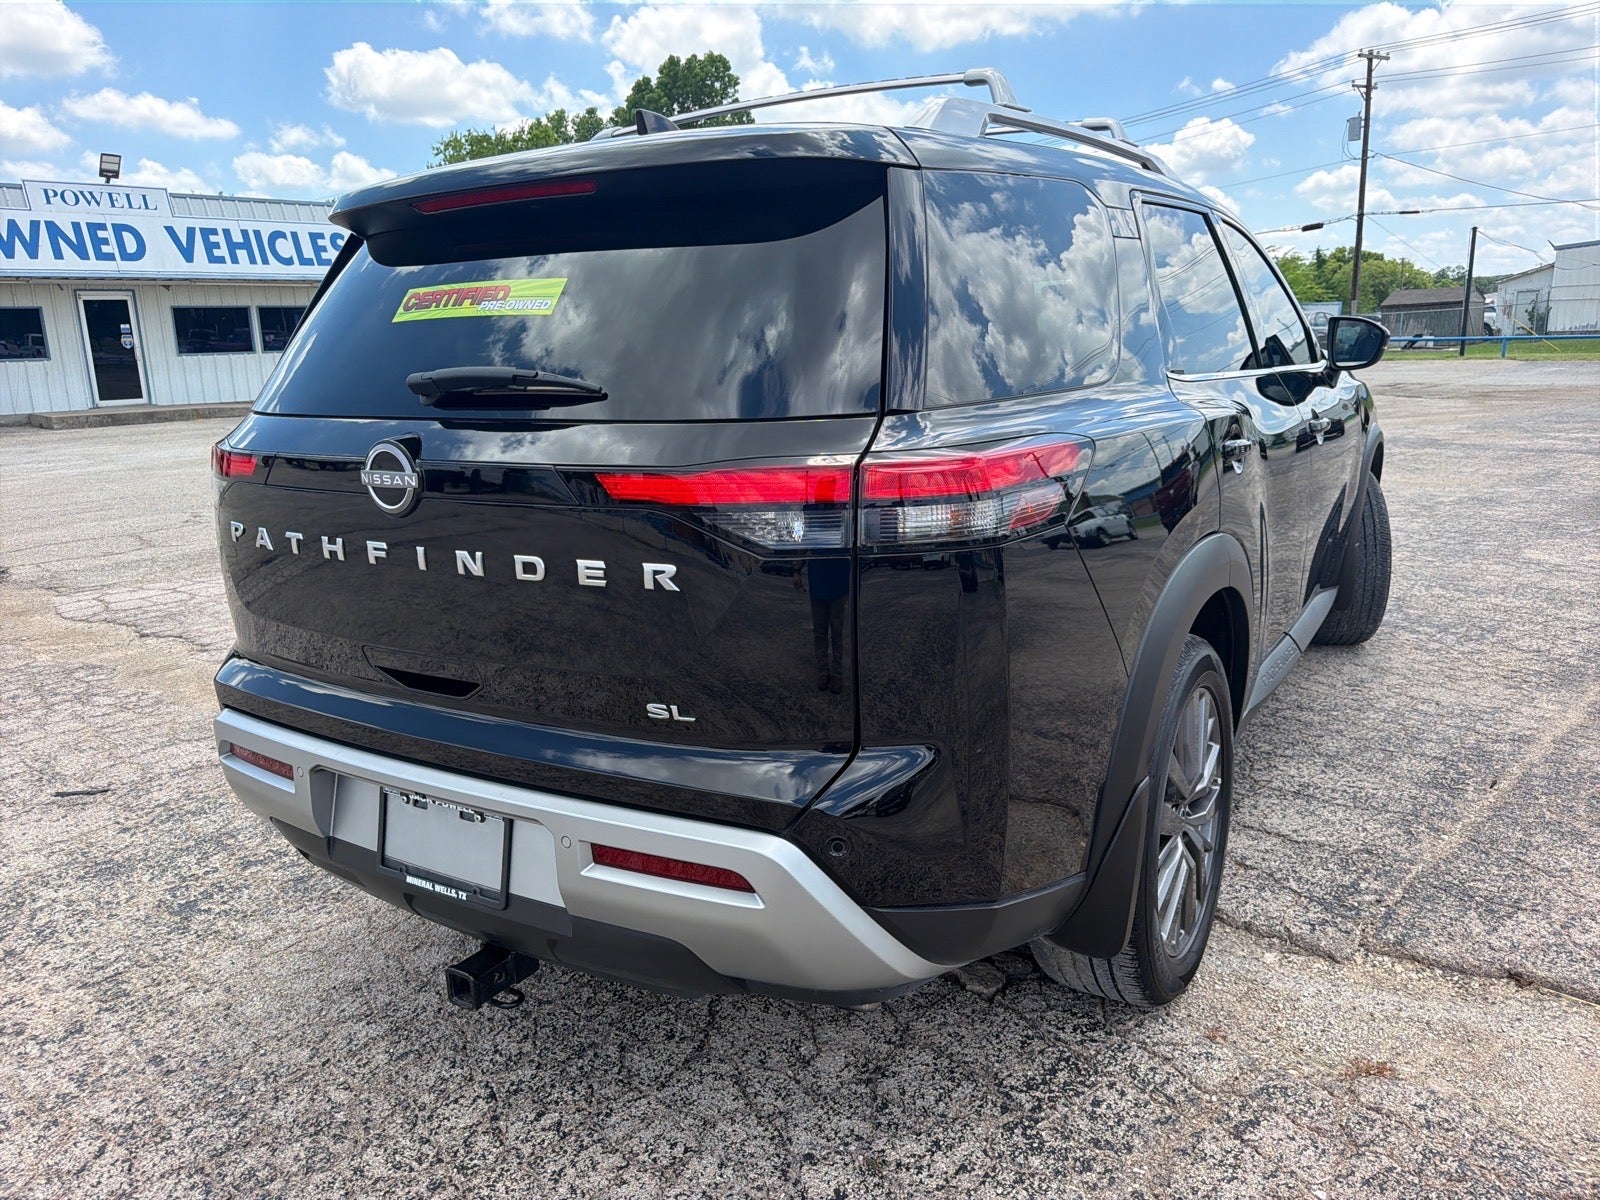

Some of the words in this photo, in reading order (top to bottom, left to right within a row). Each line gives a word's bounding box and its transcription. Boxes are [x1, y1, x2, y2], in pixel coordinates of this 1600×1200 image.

[41, 187, 158, 211] POWELL
[403, 285, 511, 312] CERTIFIED
[478, 299, 552, 311] PRE-OWNED
[361, 472, 416, 487] NISSAN
[230, 520, 681, 592] PATHFINDER
[646, 703, 696, 722] SL
[406, 875, 434, 891] MINERAL
[434, 883, 458, 899] WELLS,
[458, 890, 467, 901] TX
